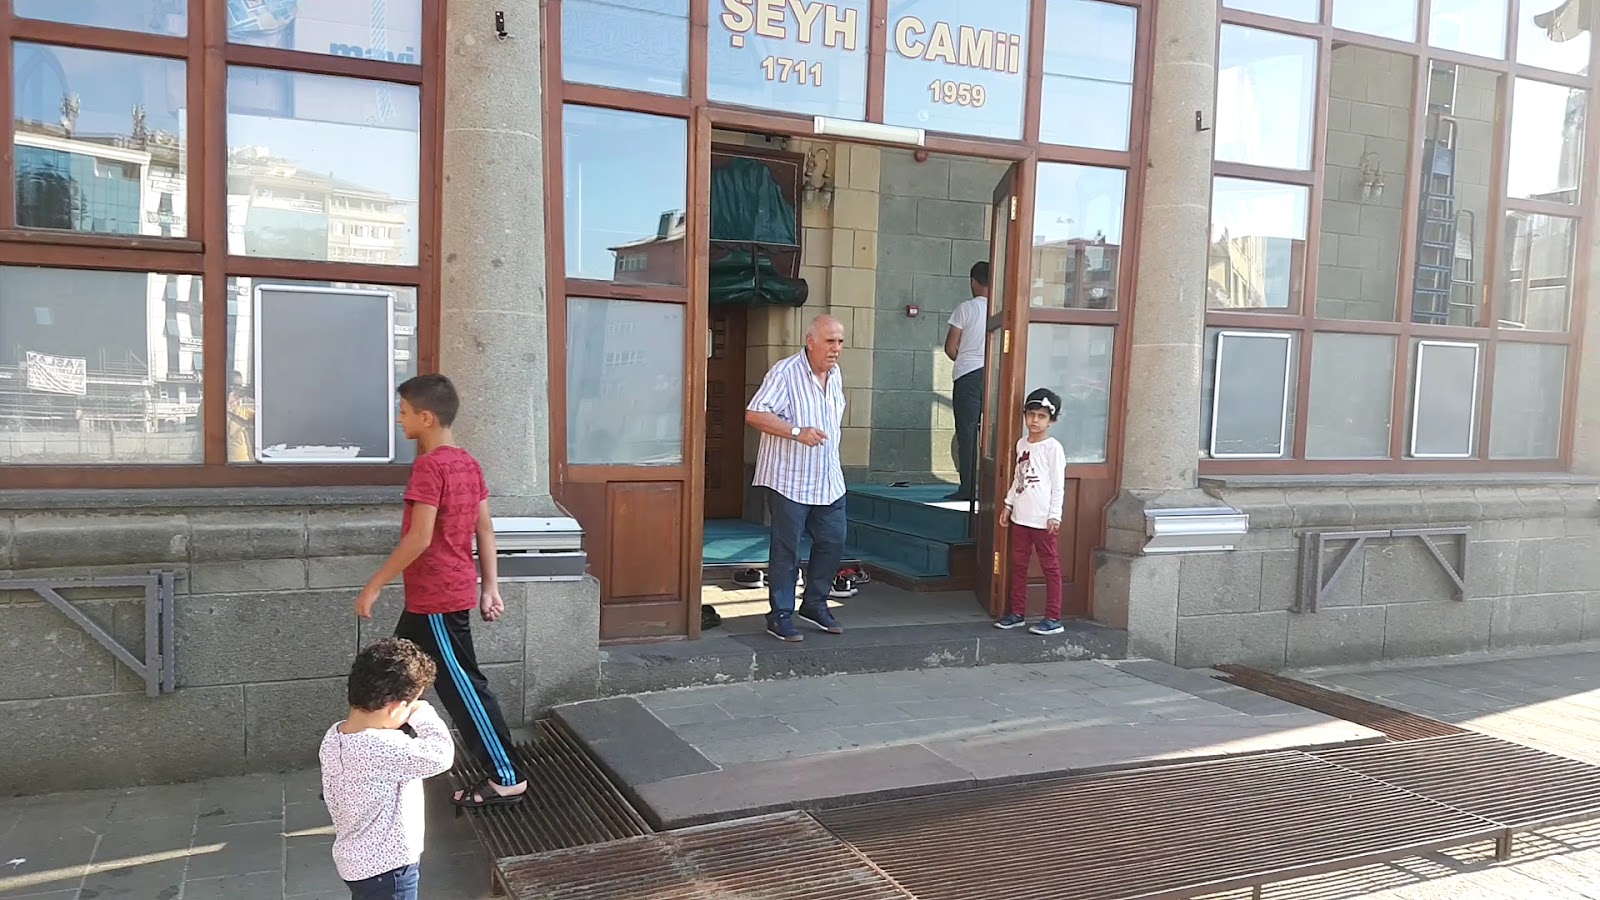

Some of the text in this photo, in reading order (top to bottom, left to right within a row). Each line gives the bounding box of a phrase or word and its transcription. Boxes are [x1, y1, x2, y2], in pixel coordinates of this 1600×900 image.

[721, 0, 857, 50] ŞEYH
[761, 56, 822, 86] 1711
[929, 80, 986, 107] 1959
